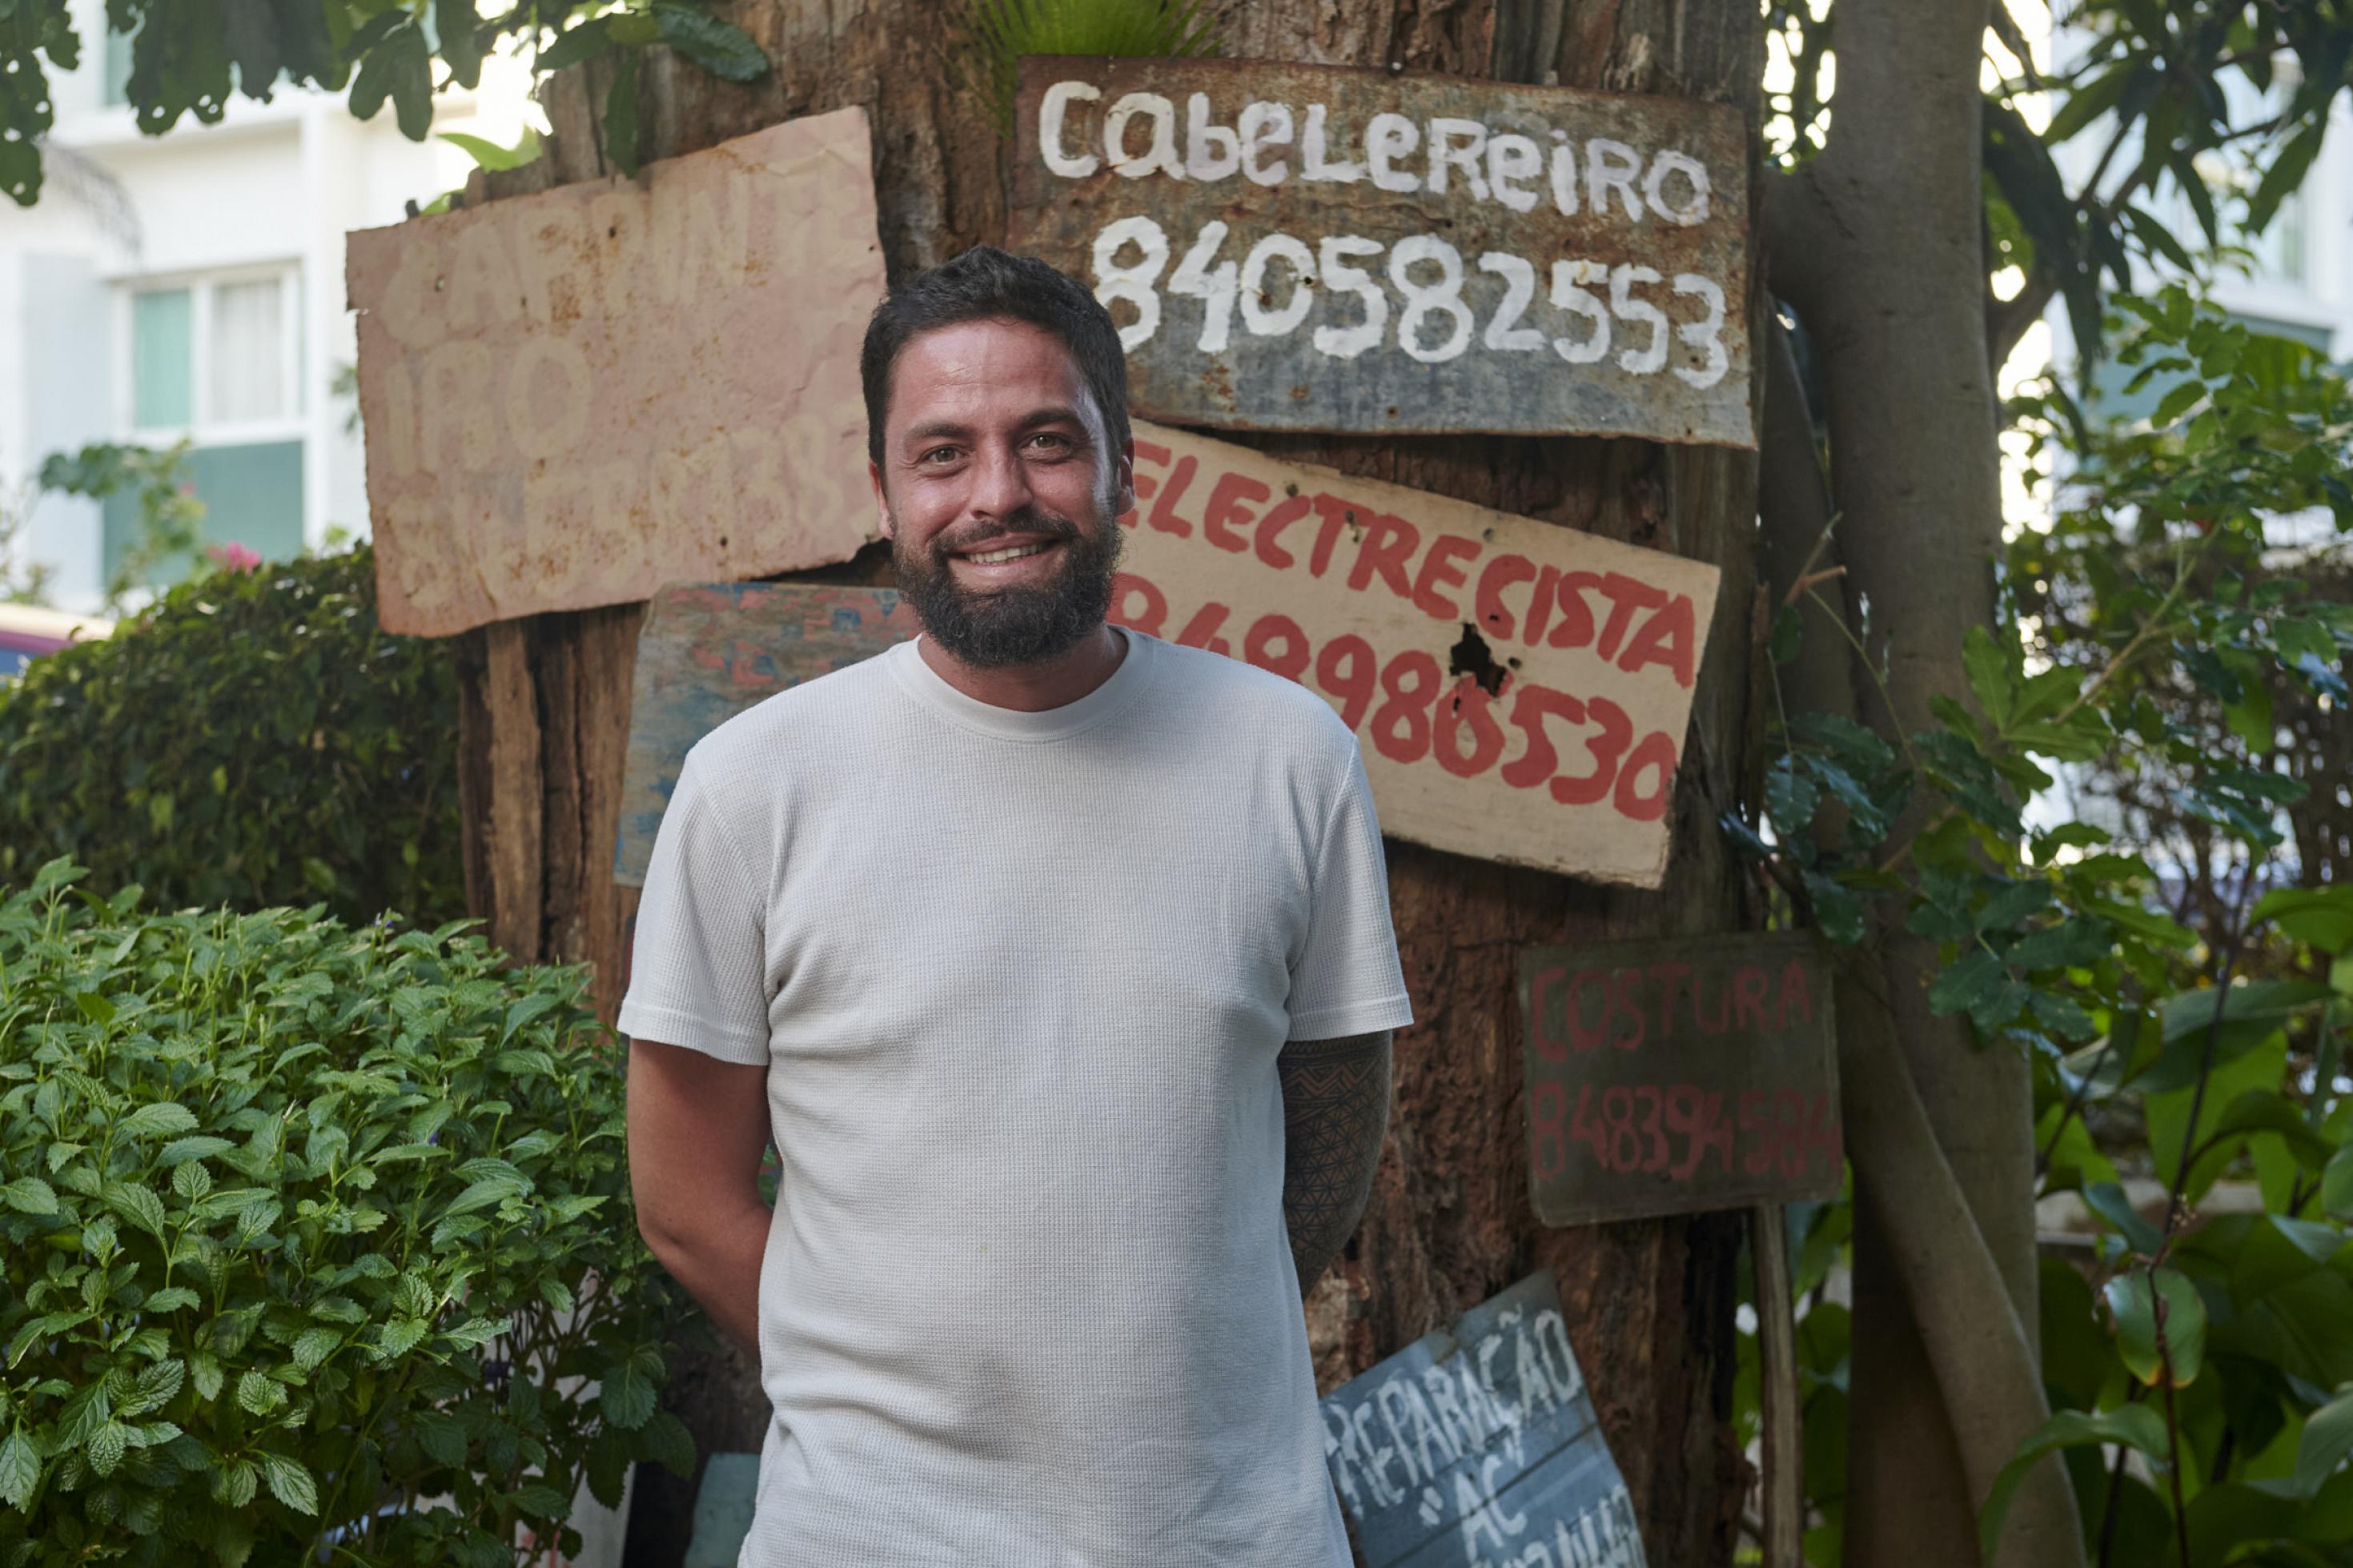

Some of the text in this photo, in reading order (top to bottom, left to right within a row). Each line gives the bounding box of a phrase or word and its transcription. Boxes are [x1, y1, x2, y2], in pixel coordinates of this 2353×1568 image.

[1091, 215, 1729, 390] 840582553
[1115, 439, 1696, 688] ELECTRECISTA
[1531, 959, 1813, 1064] COSTURA
[1531, 1081, 1843, 1181] 848394584
